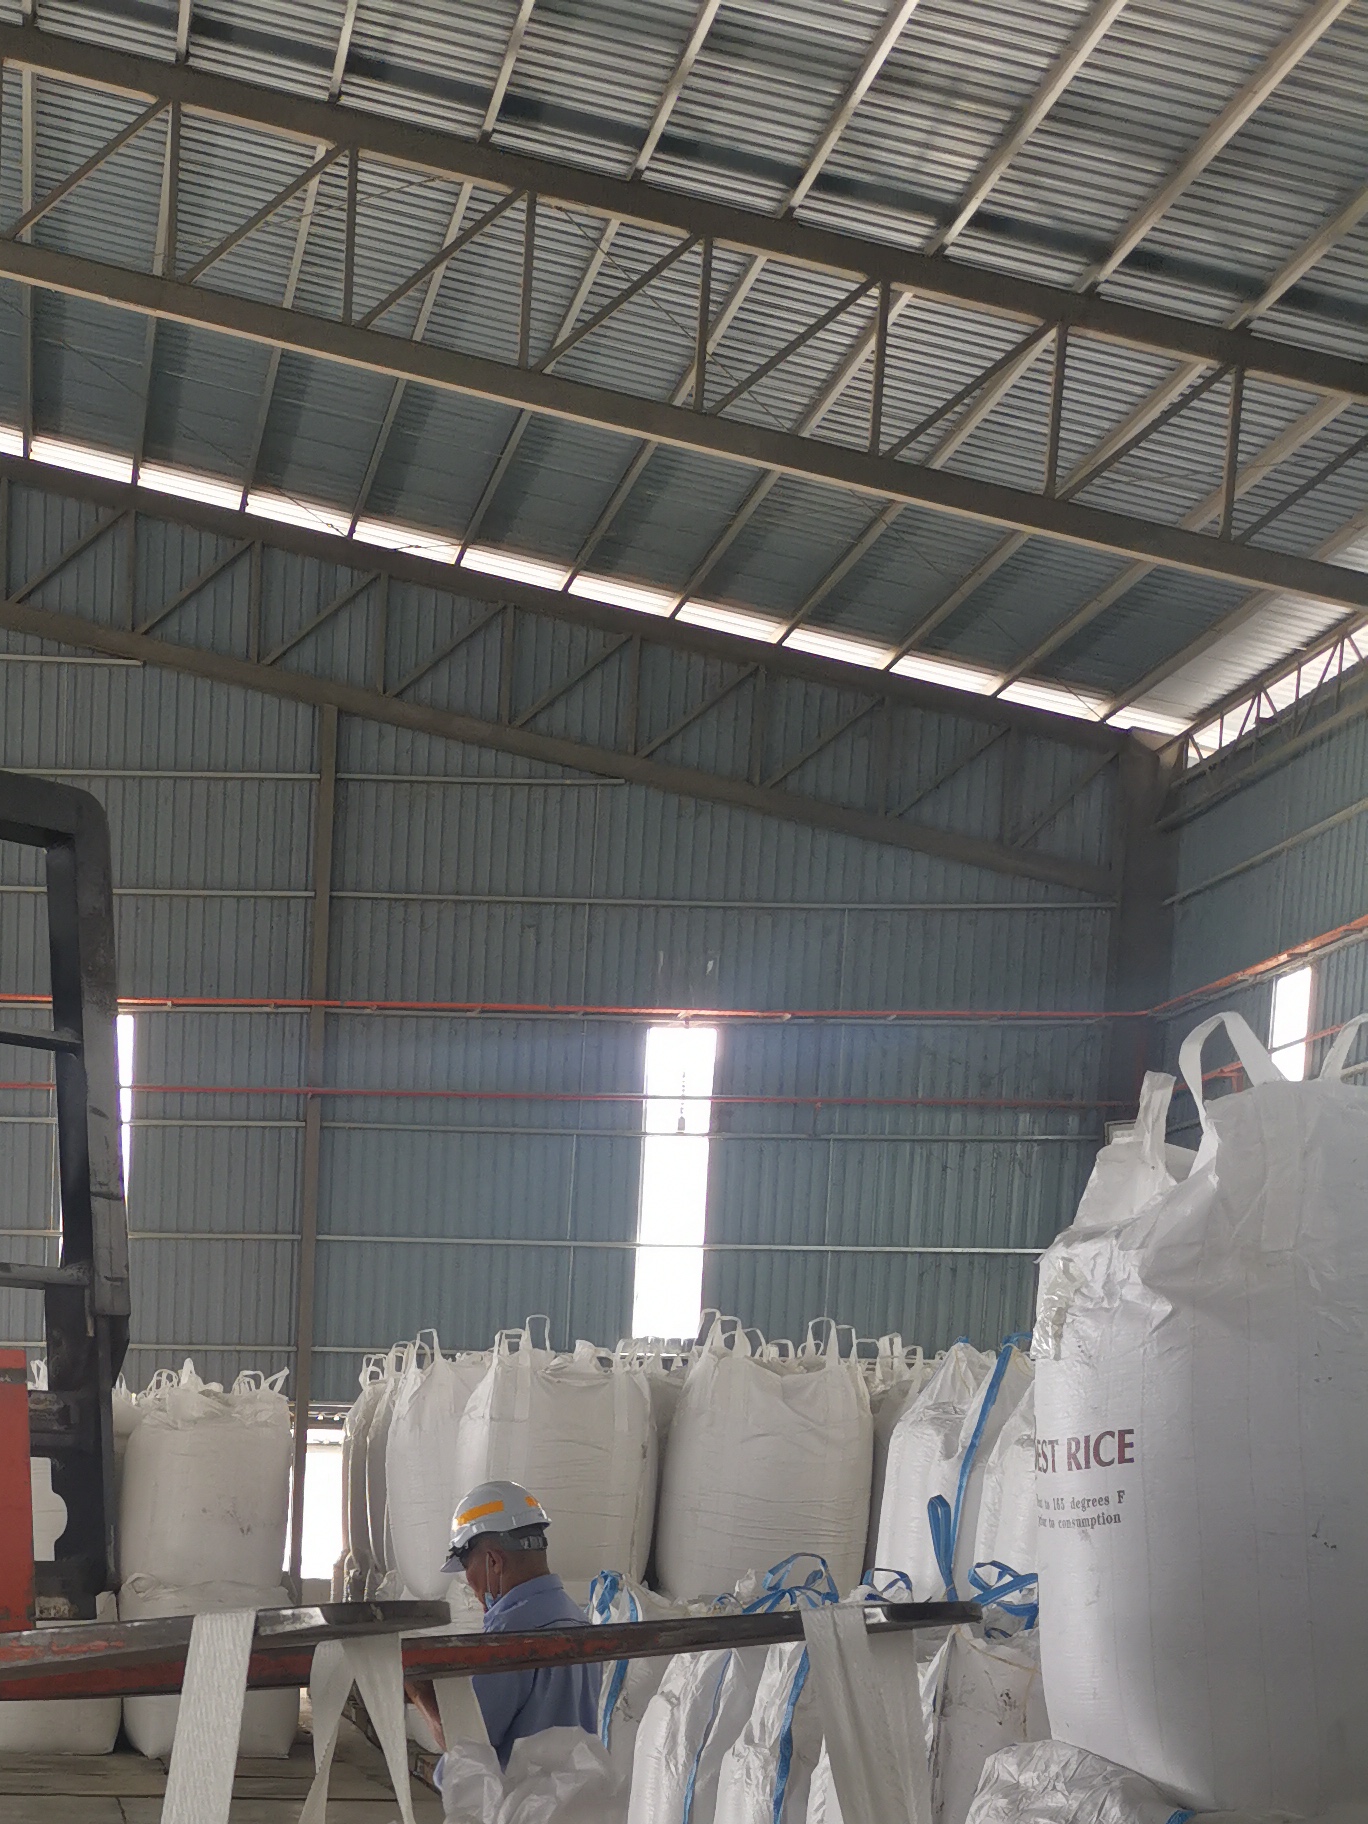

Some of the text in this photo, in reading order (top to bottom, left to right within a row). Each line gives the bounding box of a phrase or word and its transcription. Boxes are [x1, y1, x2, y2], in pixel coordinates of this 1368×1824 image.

[1035, 1429, 1134, 1474] EST RICE
[1052, 1497, 1065, 1511] 165
[1070, 1496, 1110, 1512] degrees
[1116, 1489, 1126, 1504] F
[1058, 1512, 1121, 1529] consumption
